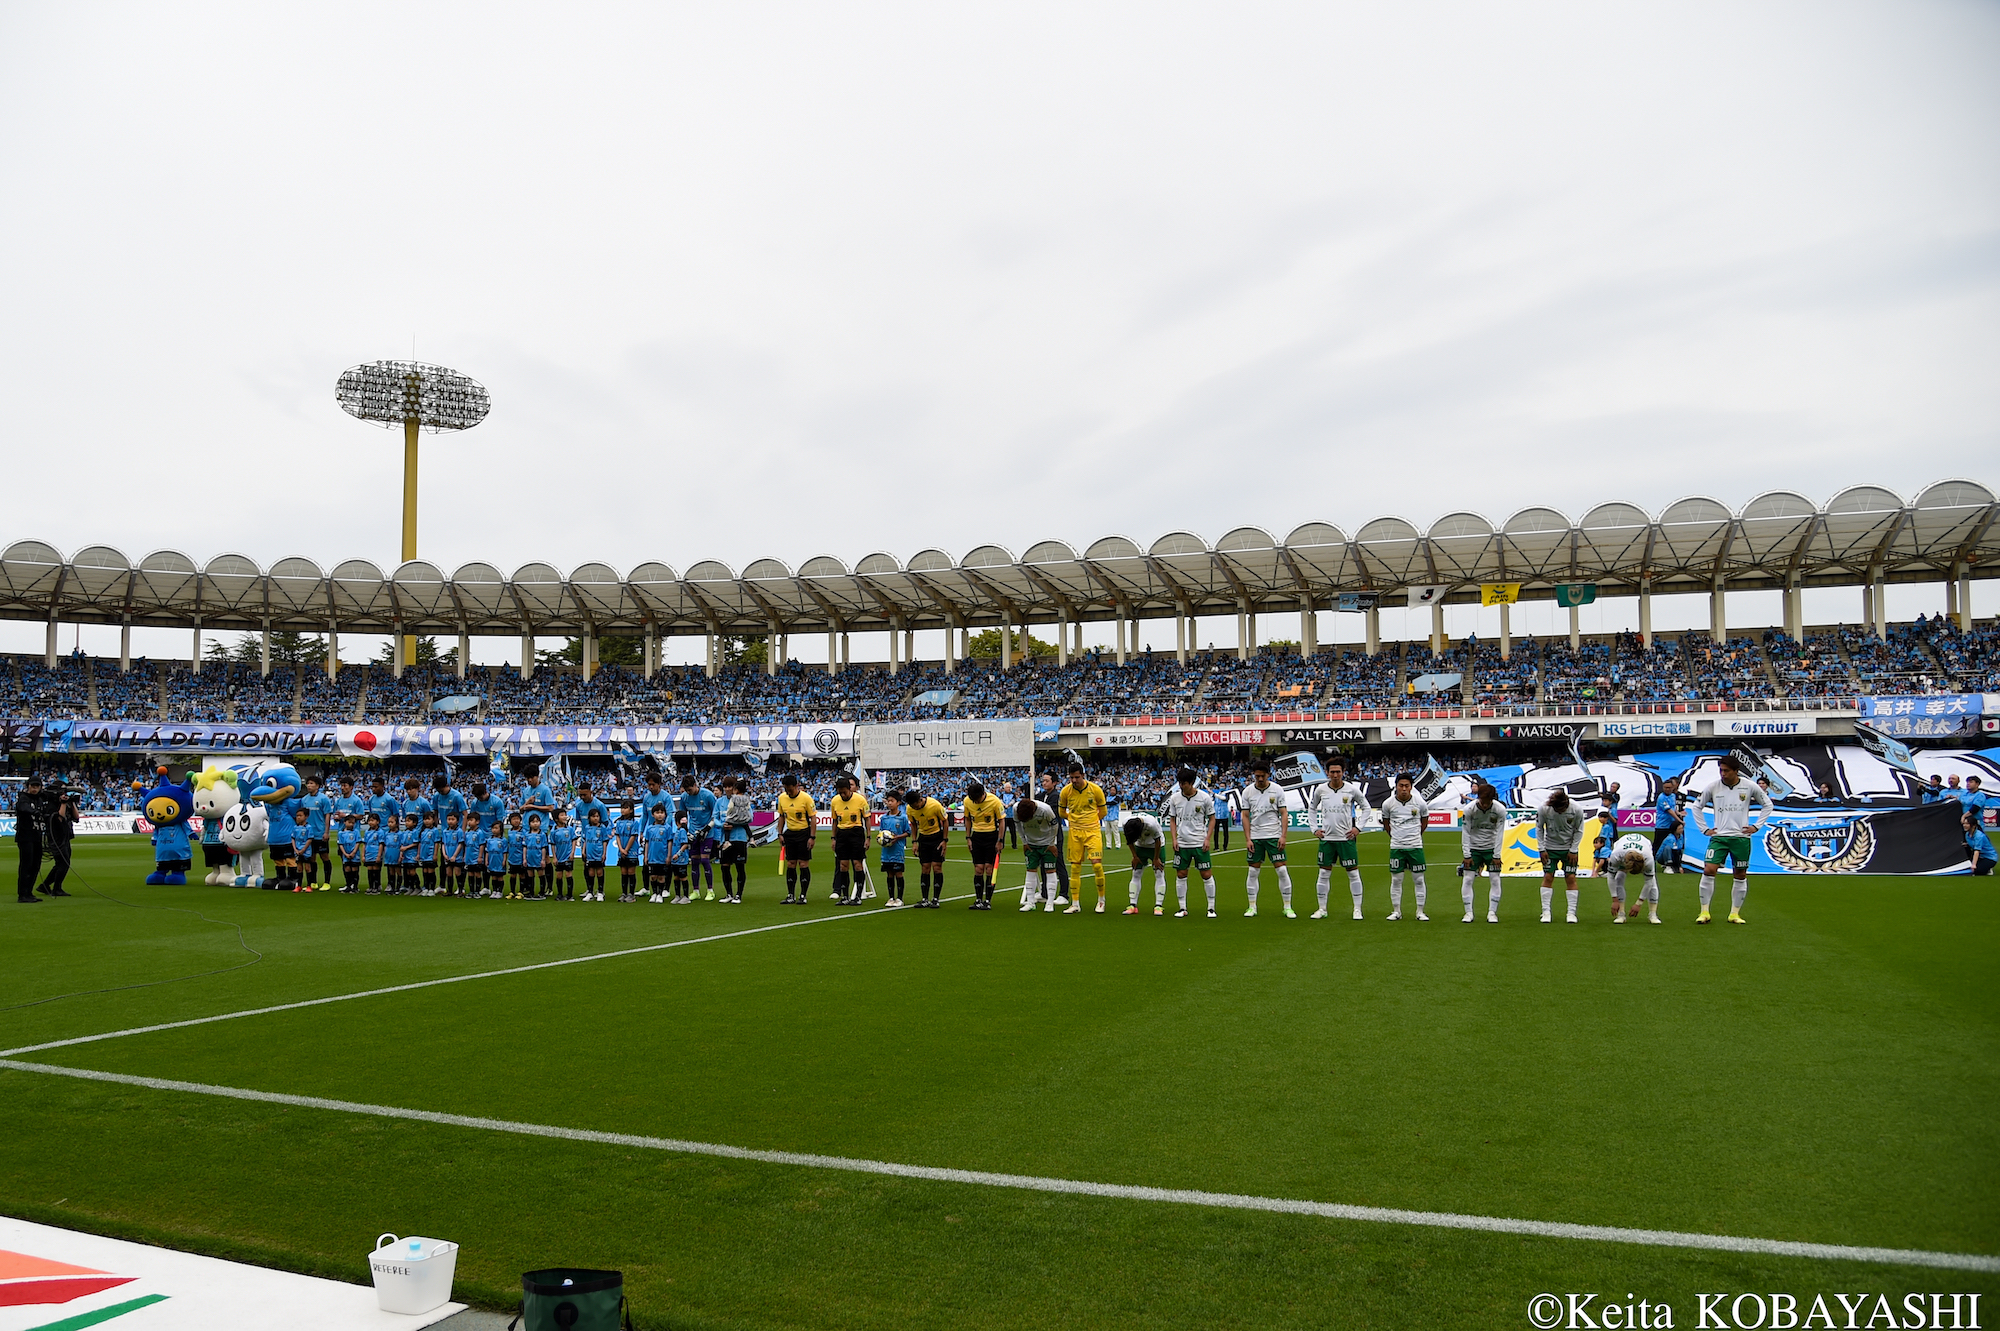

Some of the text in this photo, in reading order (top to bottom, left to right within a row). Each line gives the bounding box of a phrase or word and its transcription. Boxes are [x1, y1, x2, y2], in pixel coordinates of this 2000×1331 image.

[1873, 698, 1969, 716] 高井 幸大
[1517, 725, 1573, 738] MATSUO
[1603, 722, 1692, 735] HRS ヒロセ電機
[80, 727, 336, 750] VAI LÁ DE FRONTALE
[394, 725, 800, 755] FORZA KAWASAKI
[898, 730, 992, 748] ORIHICA
[1295, 730, 1364, 741] ALTEKNA
[1789, 827, 1847, 838] KAWASAKI
[1342, 858, 1356, 867] BRI
[373, 1263, 411, 1276] REFEREE
